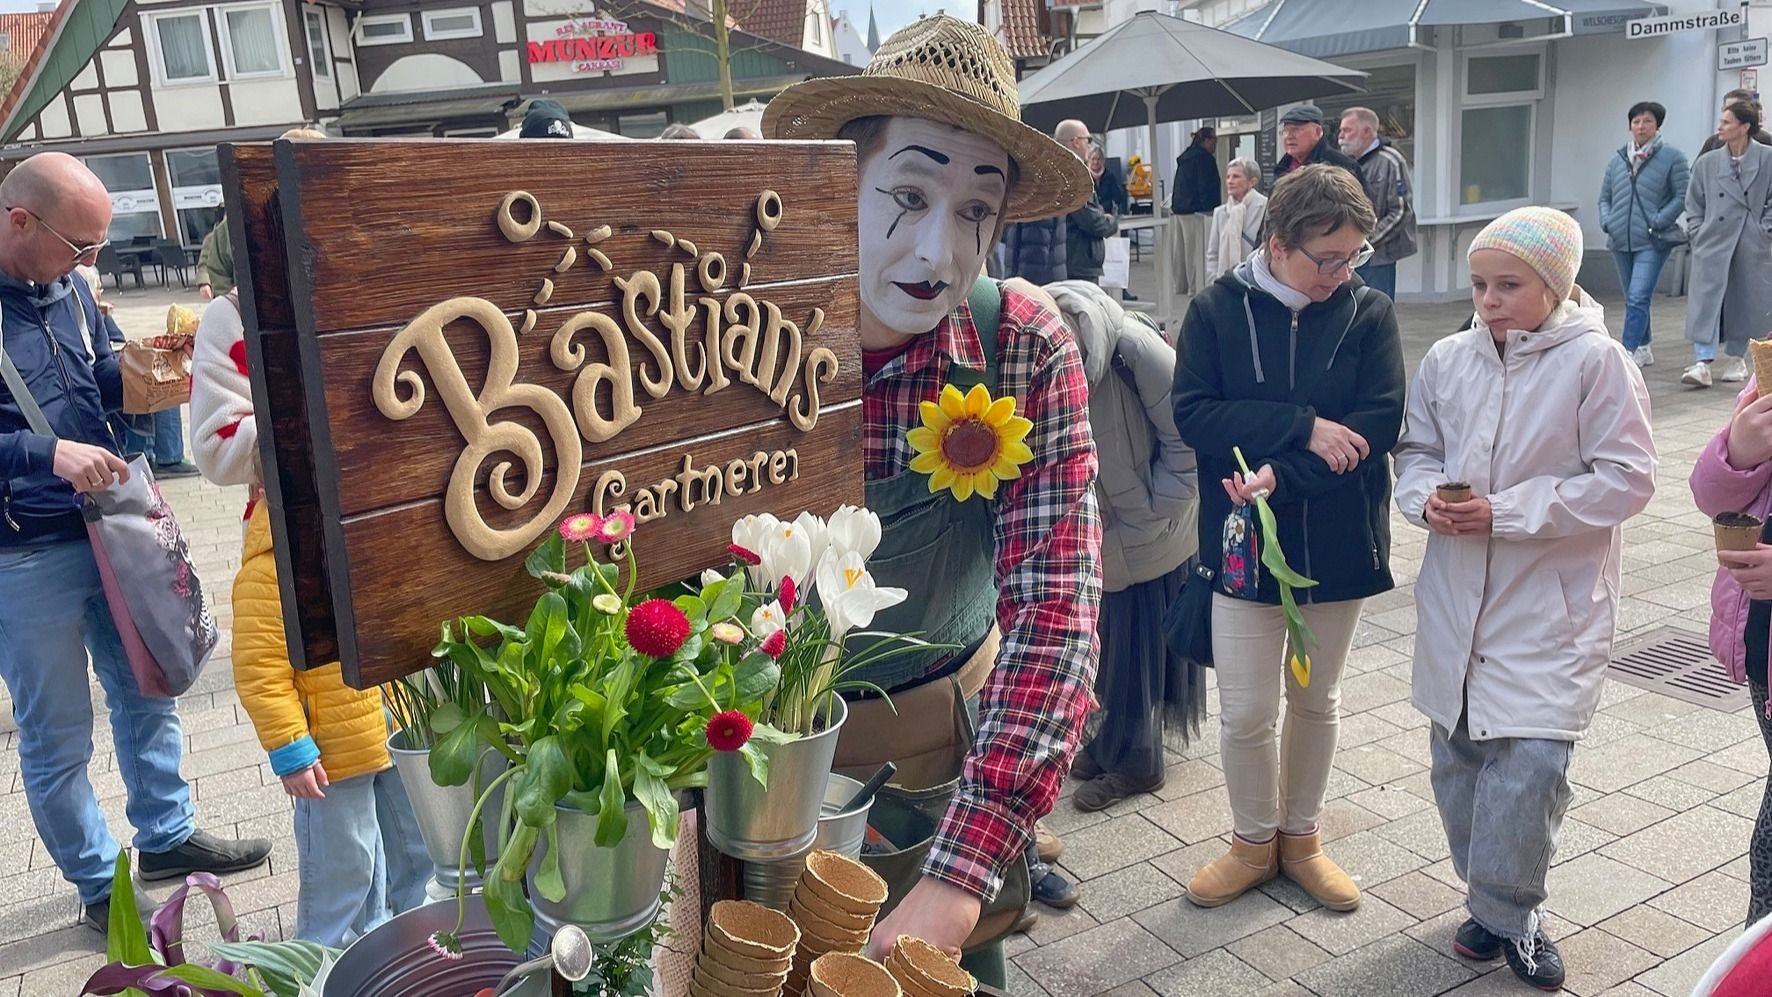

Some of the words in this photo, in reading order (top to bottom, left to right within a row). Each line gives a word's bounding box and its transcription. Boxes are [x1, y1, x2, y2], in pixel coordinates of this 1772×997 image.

[556, 21, 625, 36] RESAURANT
[1631, 11, 1740, 36] Dammstraße
[528, 32, 657, 63] MUNZUR
